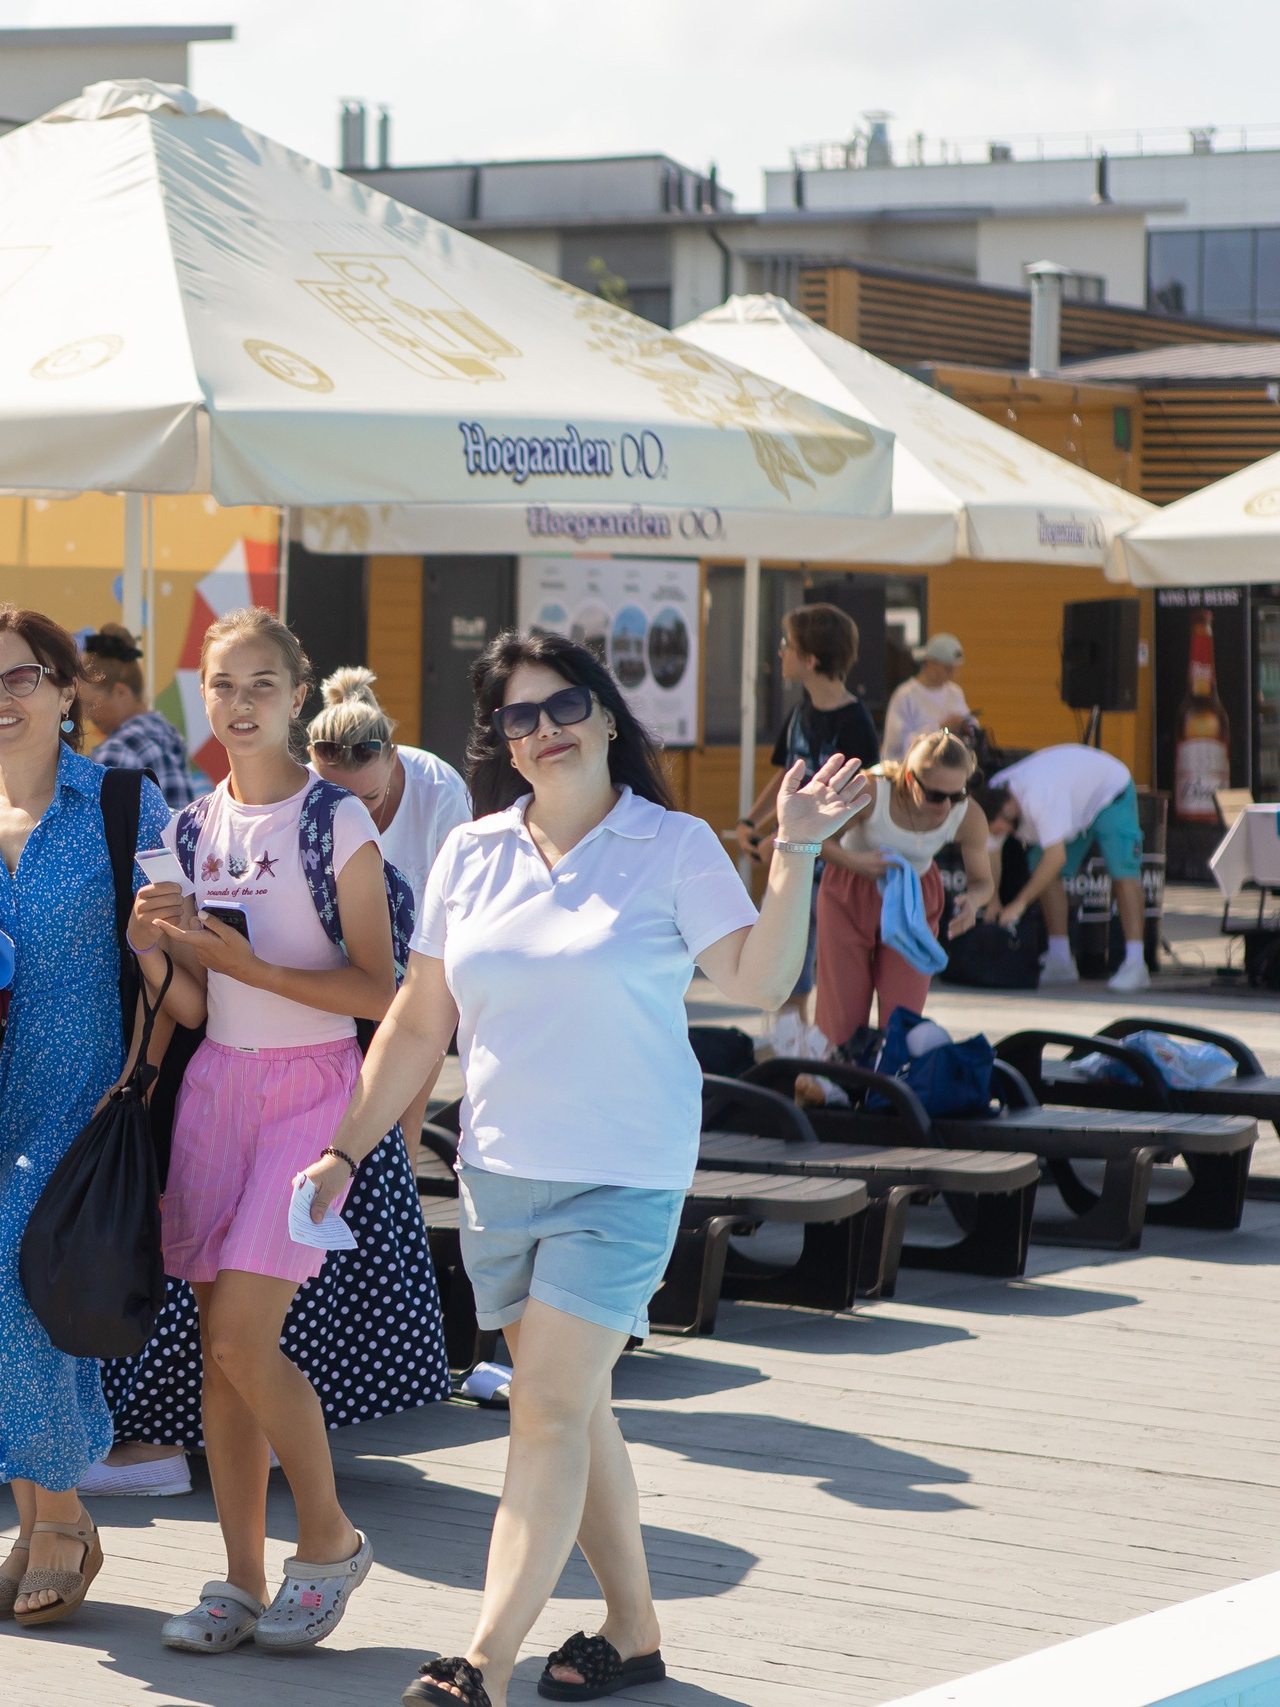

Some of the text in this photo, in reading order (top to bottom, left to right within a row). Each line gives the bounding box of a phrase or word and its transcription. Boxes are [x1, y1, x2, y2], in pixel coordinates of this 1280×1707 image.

[459, 421, 613, 484] Hoegaarden
[526, 504, 671, 542] Hoegaarden
[206, 887, 230, 896] sounds
[231, 887, 241, 898] of
[241, 887, 253, 896] the
